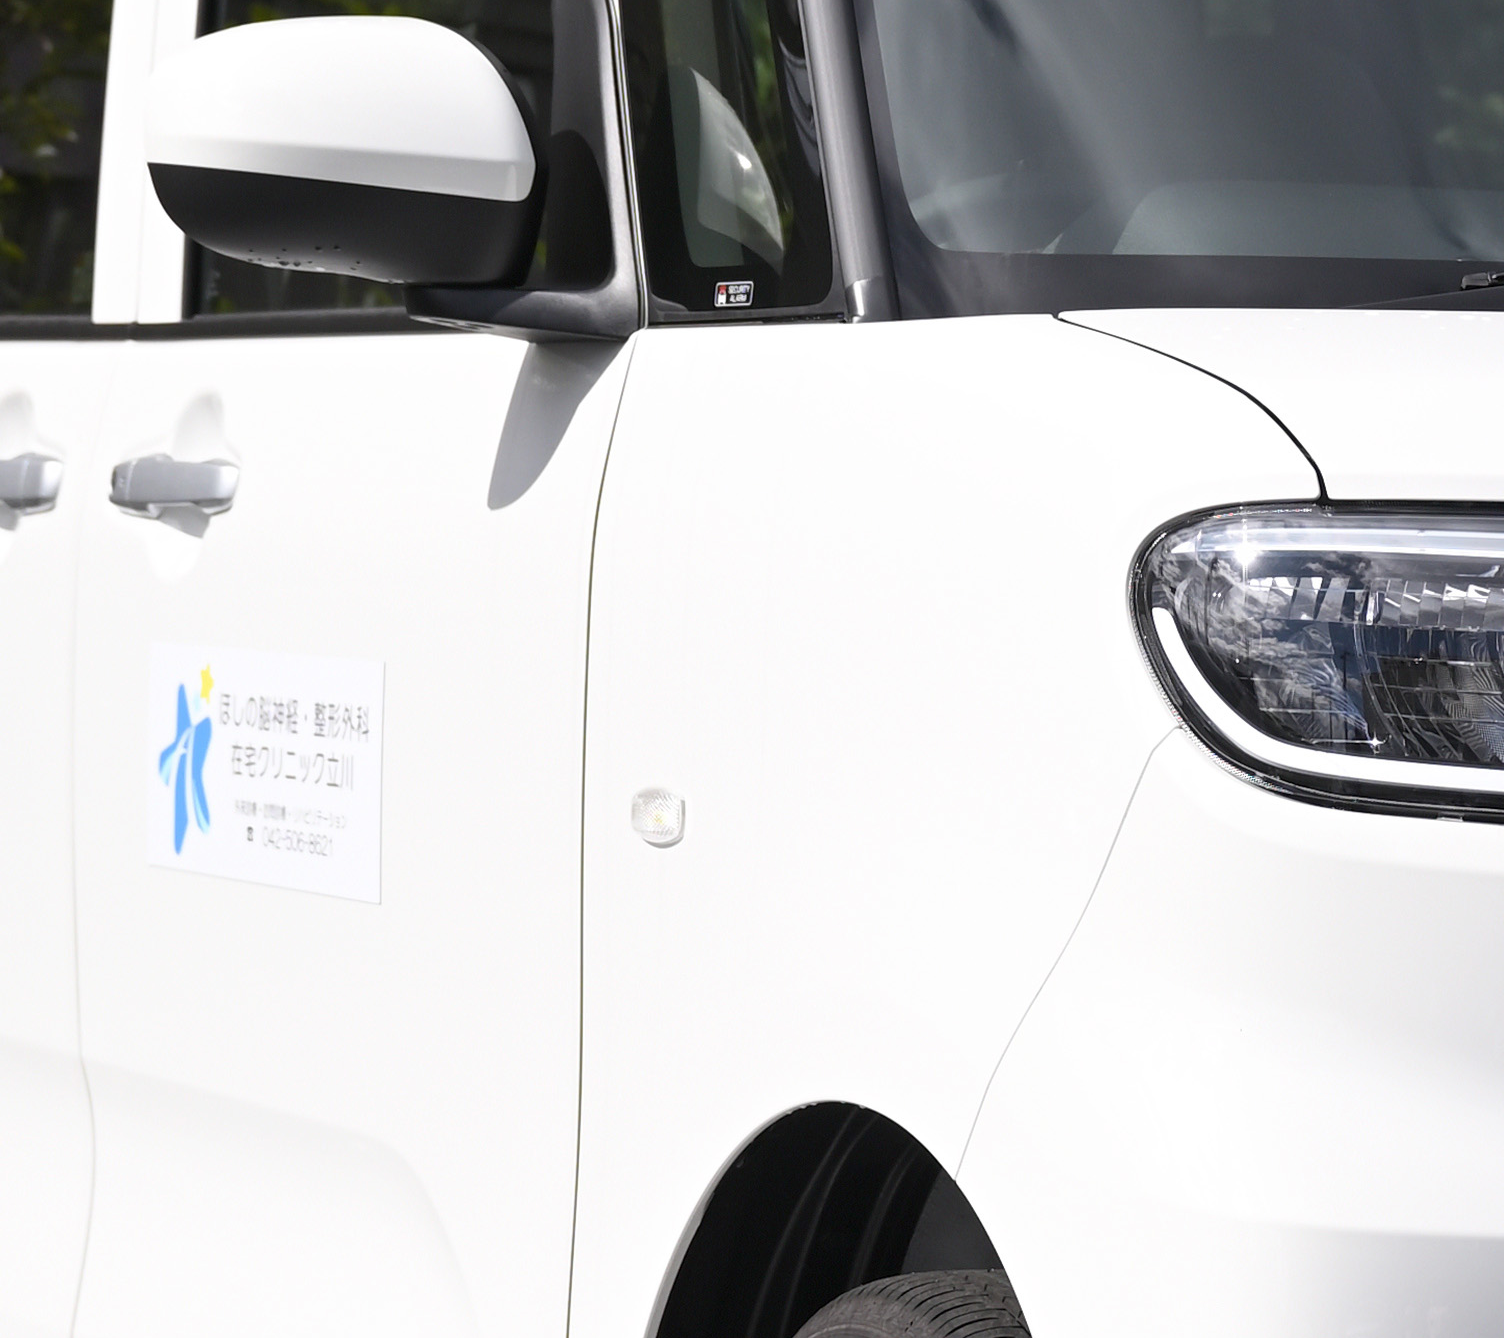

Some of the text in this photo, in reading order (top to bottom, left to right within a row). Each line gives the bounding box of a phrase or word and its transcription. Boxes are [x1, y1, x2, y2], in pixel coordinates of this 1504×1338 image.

[231, 741, 355, 790] 在宅クリニック立川
